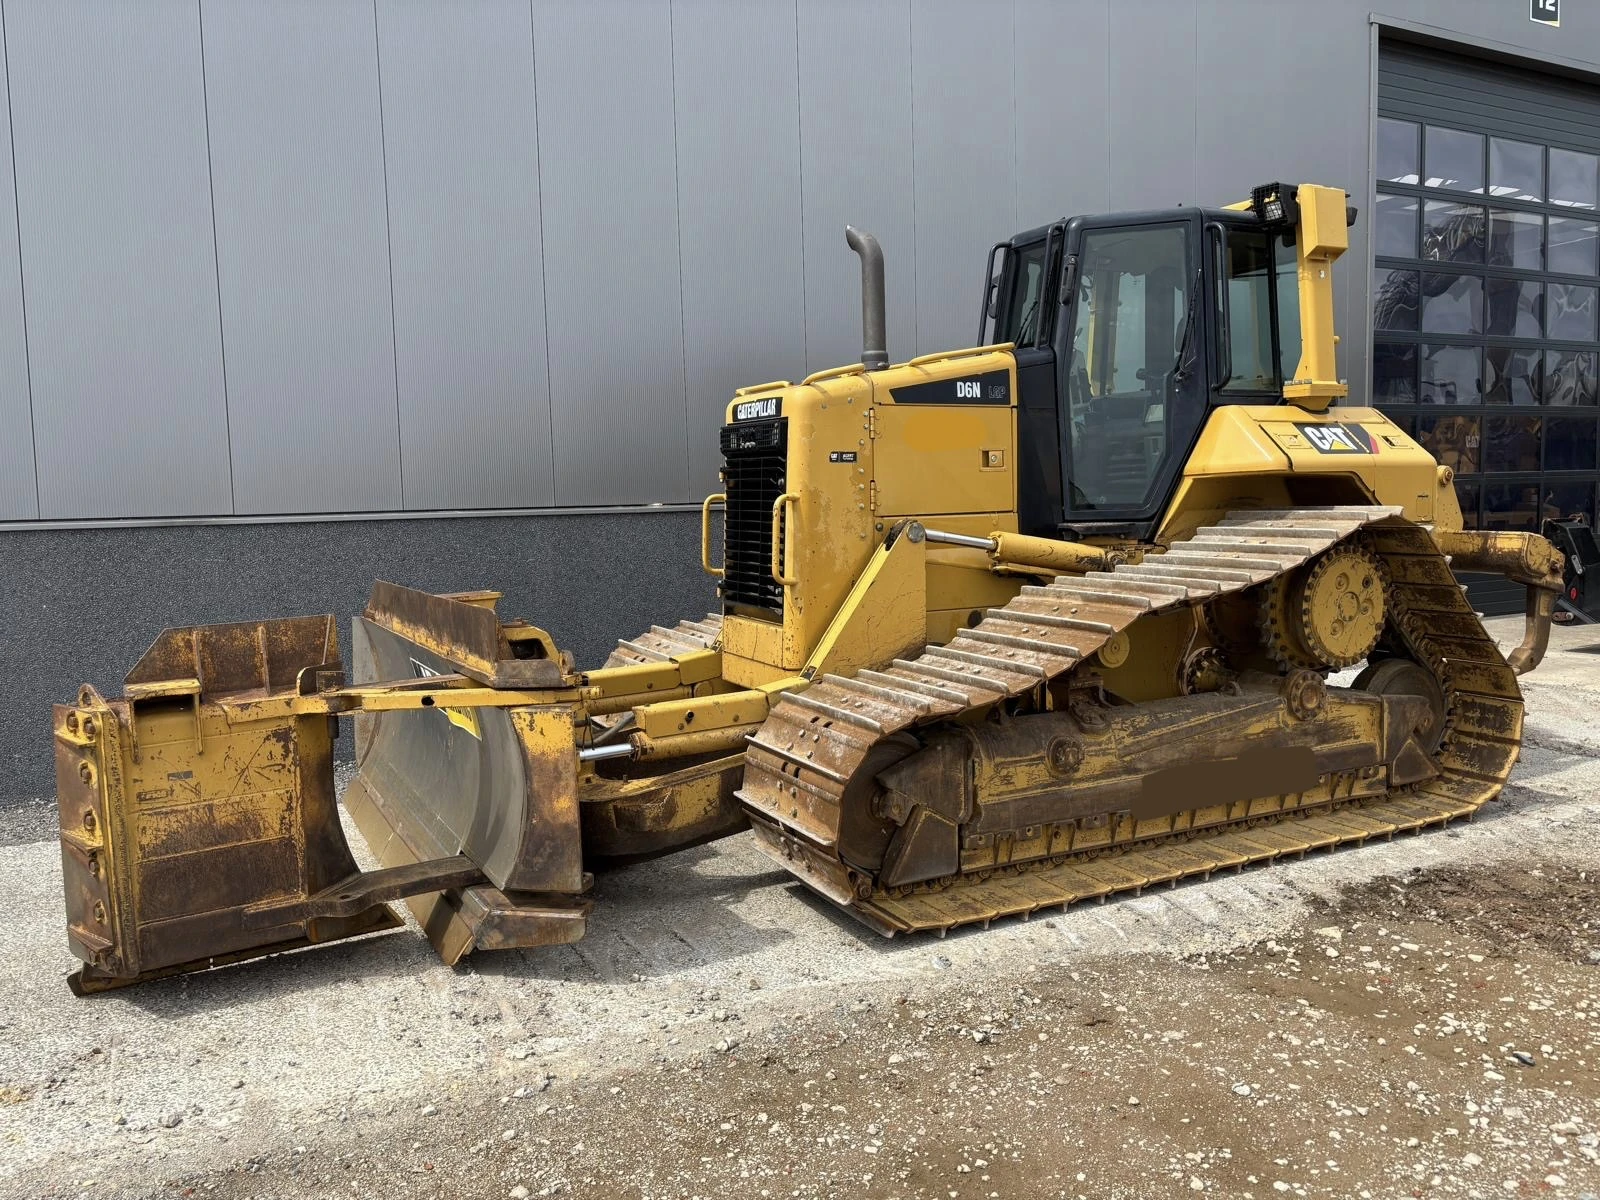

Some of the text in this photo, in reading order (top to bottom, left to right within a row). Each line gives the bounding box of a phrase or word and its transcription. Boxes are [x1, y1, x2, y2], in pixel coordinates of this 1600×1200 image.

[956, 381, 981, 398] D6N
[737, 399, 776, 420] CATERPILLAR
[1304, 426, 1358, 450] CAT
